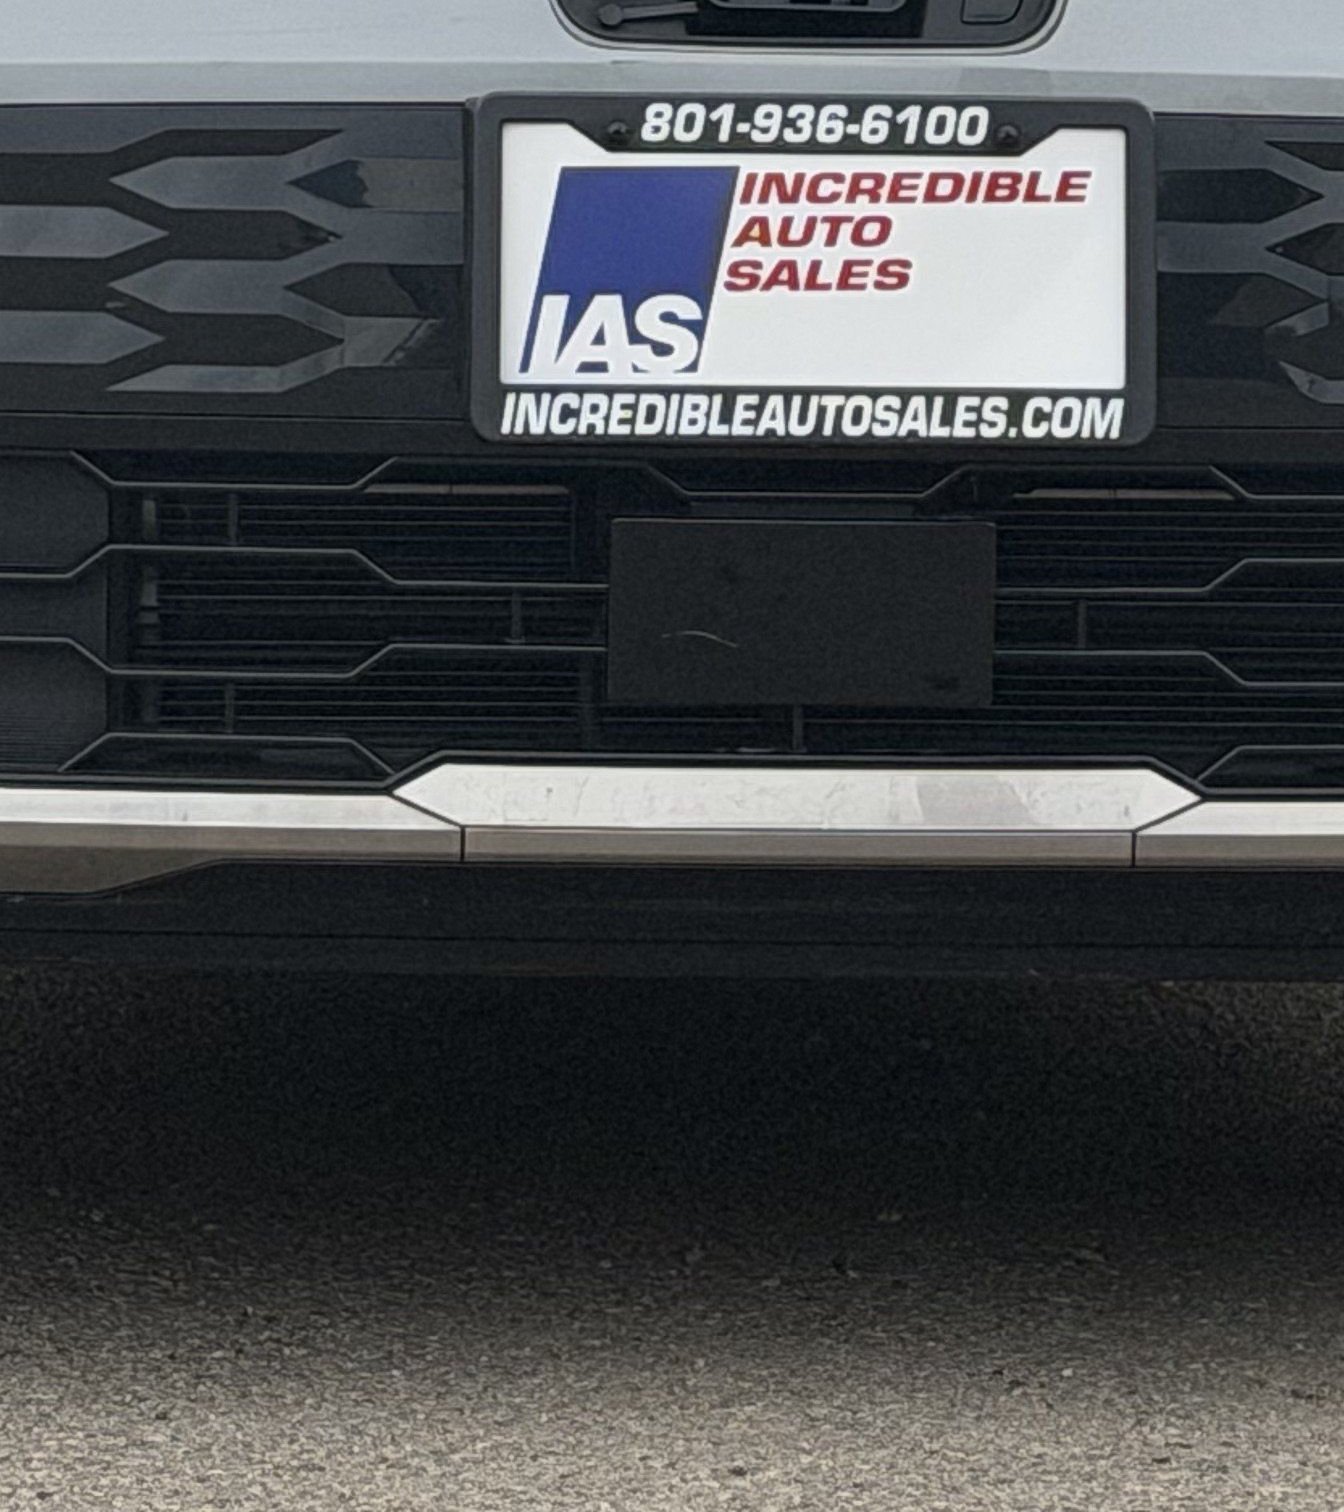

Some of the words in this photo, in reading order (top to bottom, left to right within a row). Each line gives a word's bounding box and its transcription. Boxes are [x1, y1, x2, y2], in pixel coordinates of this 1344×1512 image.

[641, 102, 990, 146] 801-936-6100
[737, 170, 1092, 205] INCREDIBLE
[731, 215, 893, 249] AUTO
[723, 258, 913, 291] SALES
[526, 293, 703, 374] IAS
[500, 392, 1124, 440] INCREDIBLEAUTOSALES.COM
